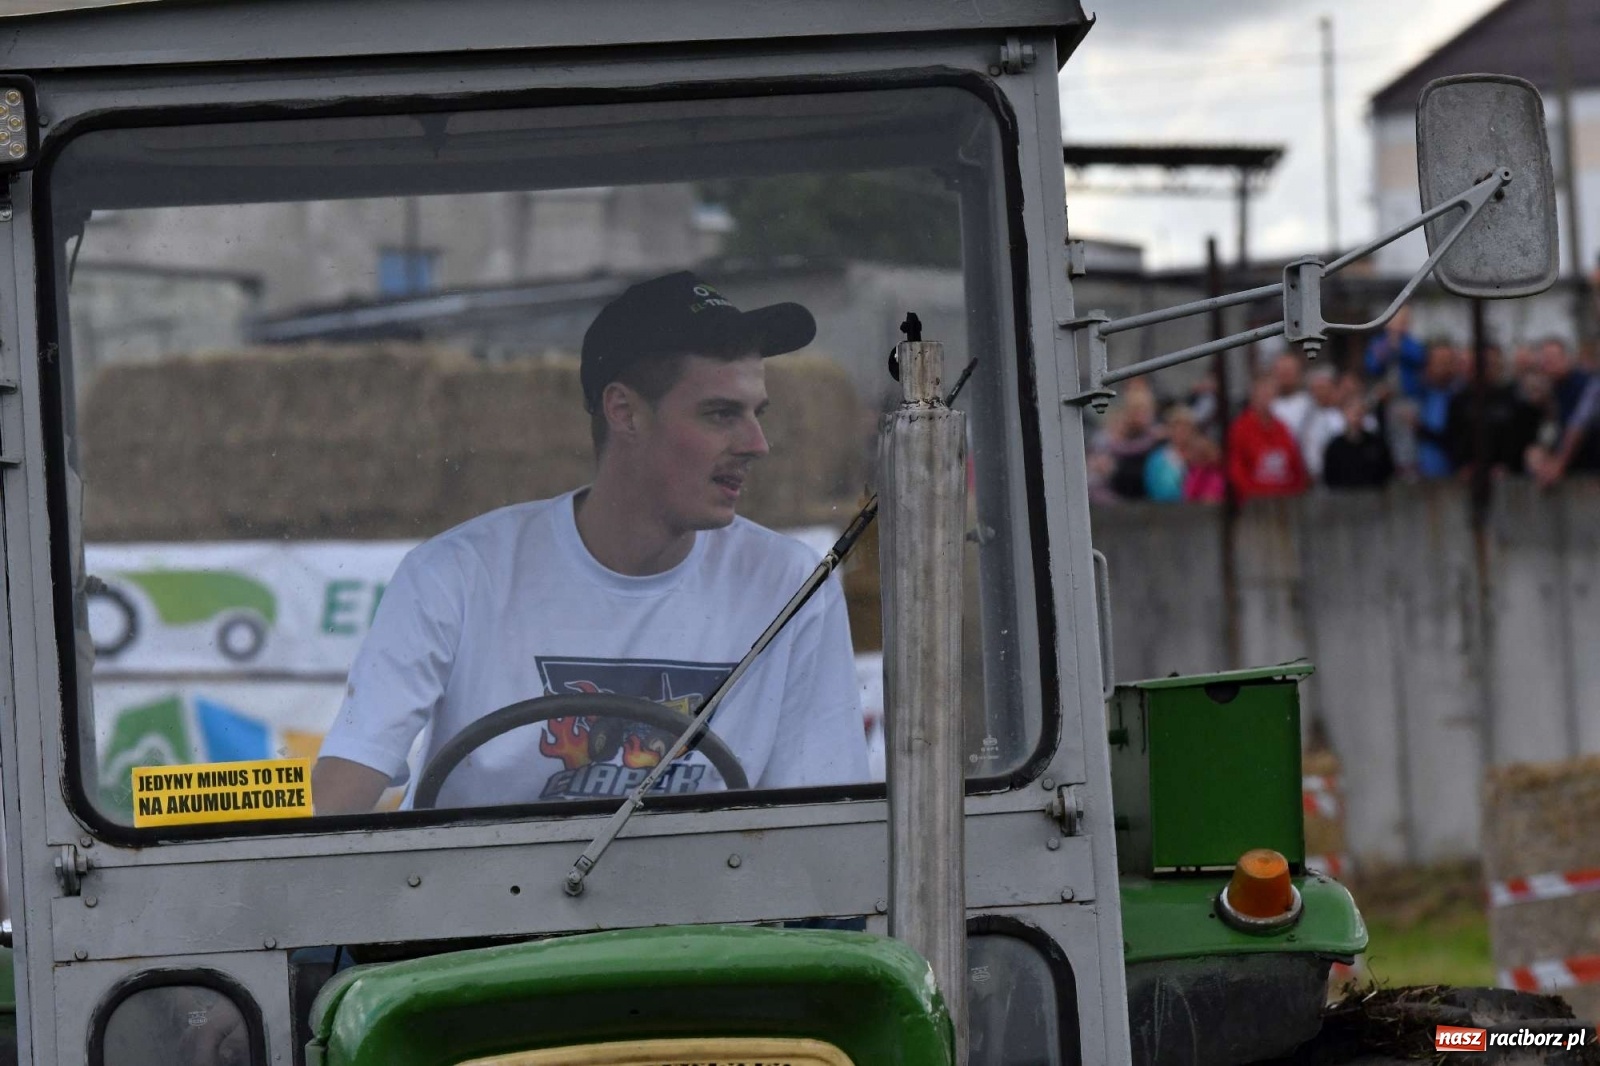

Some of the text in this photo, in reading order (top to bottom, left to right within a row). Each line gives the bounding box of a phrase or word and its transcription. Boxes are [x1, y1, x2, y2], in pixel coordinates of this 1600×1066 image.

[138, 766, 304, 792] JEDYNY MINUS TO TEN
[139, 788, 306, 816] NA AKUMULATORZE
